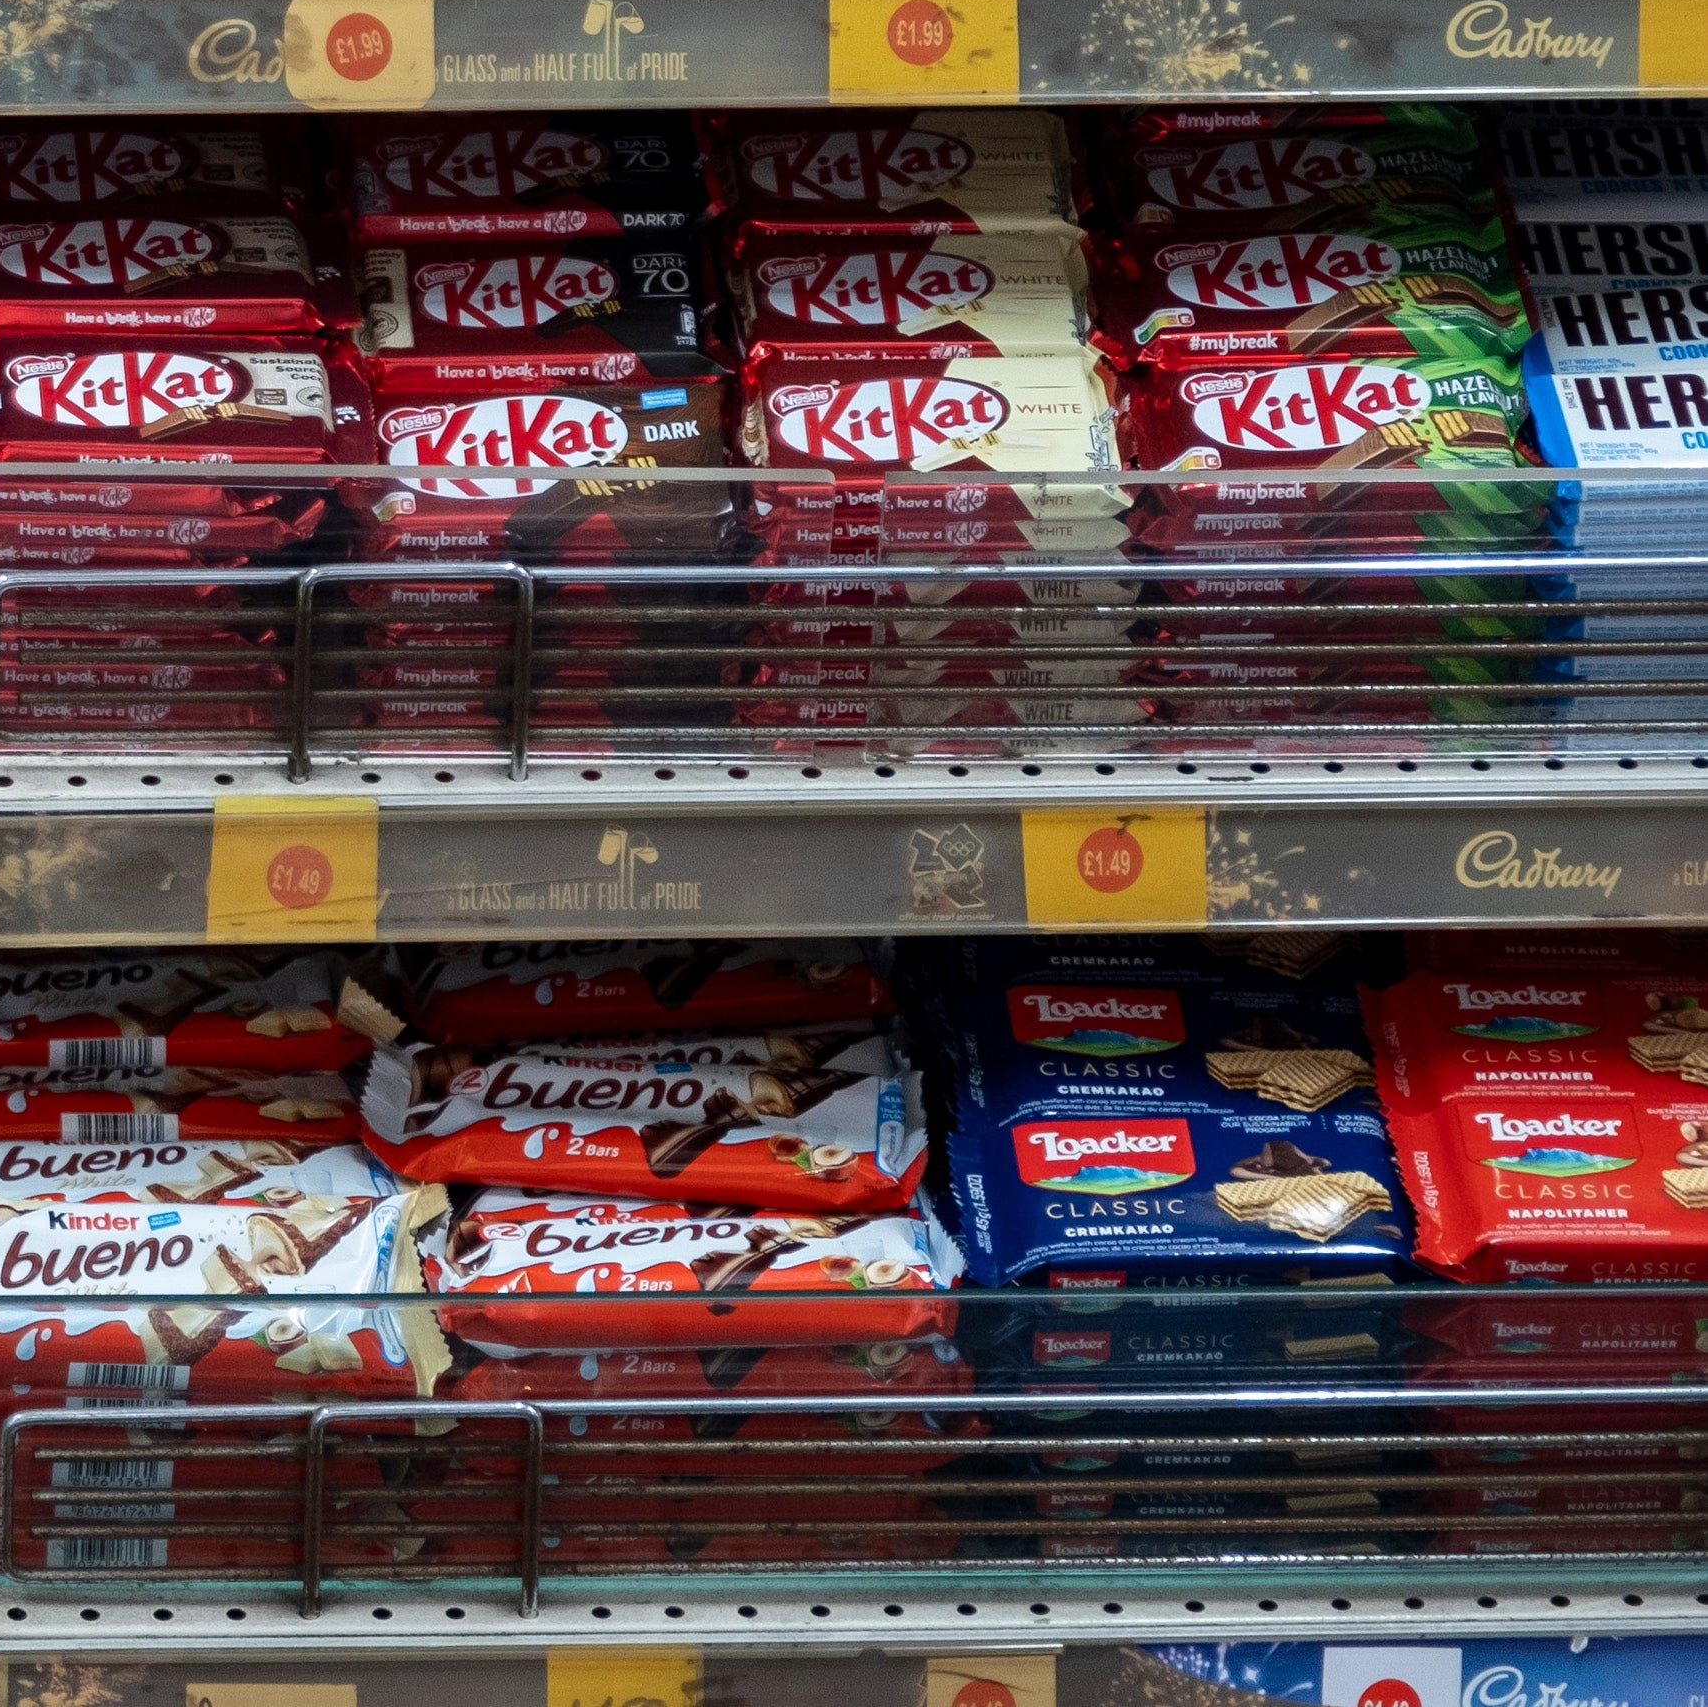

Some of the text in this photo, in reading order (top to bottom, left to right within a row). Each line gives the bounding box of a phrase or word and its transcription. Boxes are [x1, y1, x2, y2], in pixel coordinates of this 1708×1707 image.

[897, 20, 944, 48] £1.99
[1446, 0, 1614, 68] Cadbury
[335, 29, 384, 65] £1.99
[1190, 332, 1278, 352] #mybreak
[1015, 402, 1082, 414] WHITE
[643, 421, 698, 441] DARK
[401, 531, 489, 551] #mybreak
[1083, 849, 1131, 877] £1.49
[1455, 831, 1622, 896] Cadbury
[272, 866, 320, 894] £1.49
[483, 1063, 704, 1110] bueno
[566, 1137, 619, 1158] 2 Bars
[1030, 1132, 1177, 1161] Loacker
[49, 1211, 140, 1231] Kinder
[1045, 1200, 1186, 1220] CLASSIC
[1508, 1209, 1629, 1220] NAPOLITANER
[1064, 1226, 1174, 1238] CREMKAKAO
[1, 1232, 193, 1289] bueno
